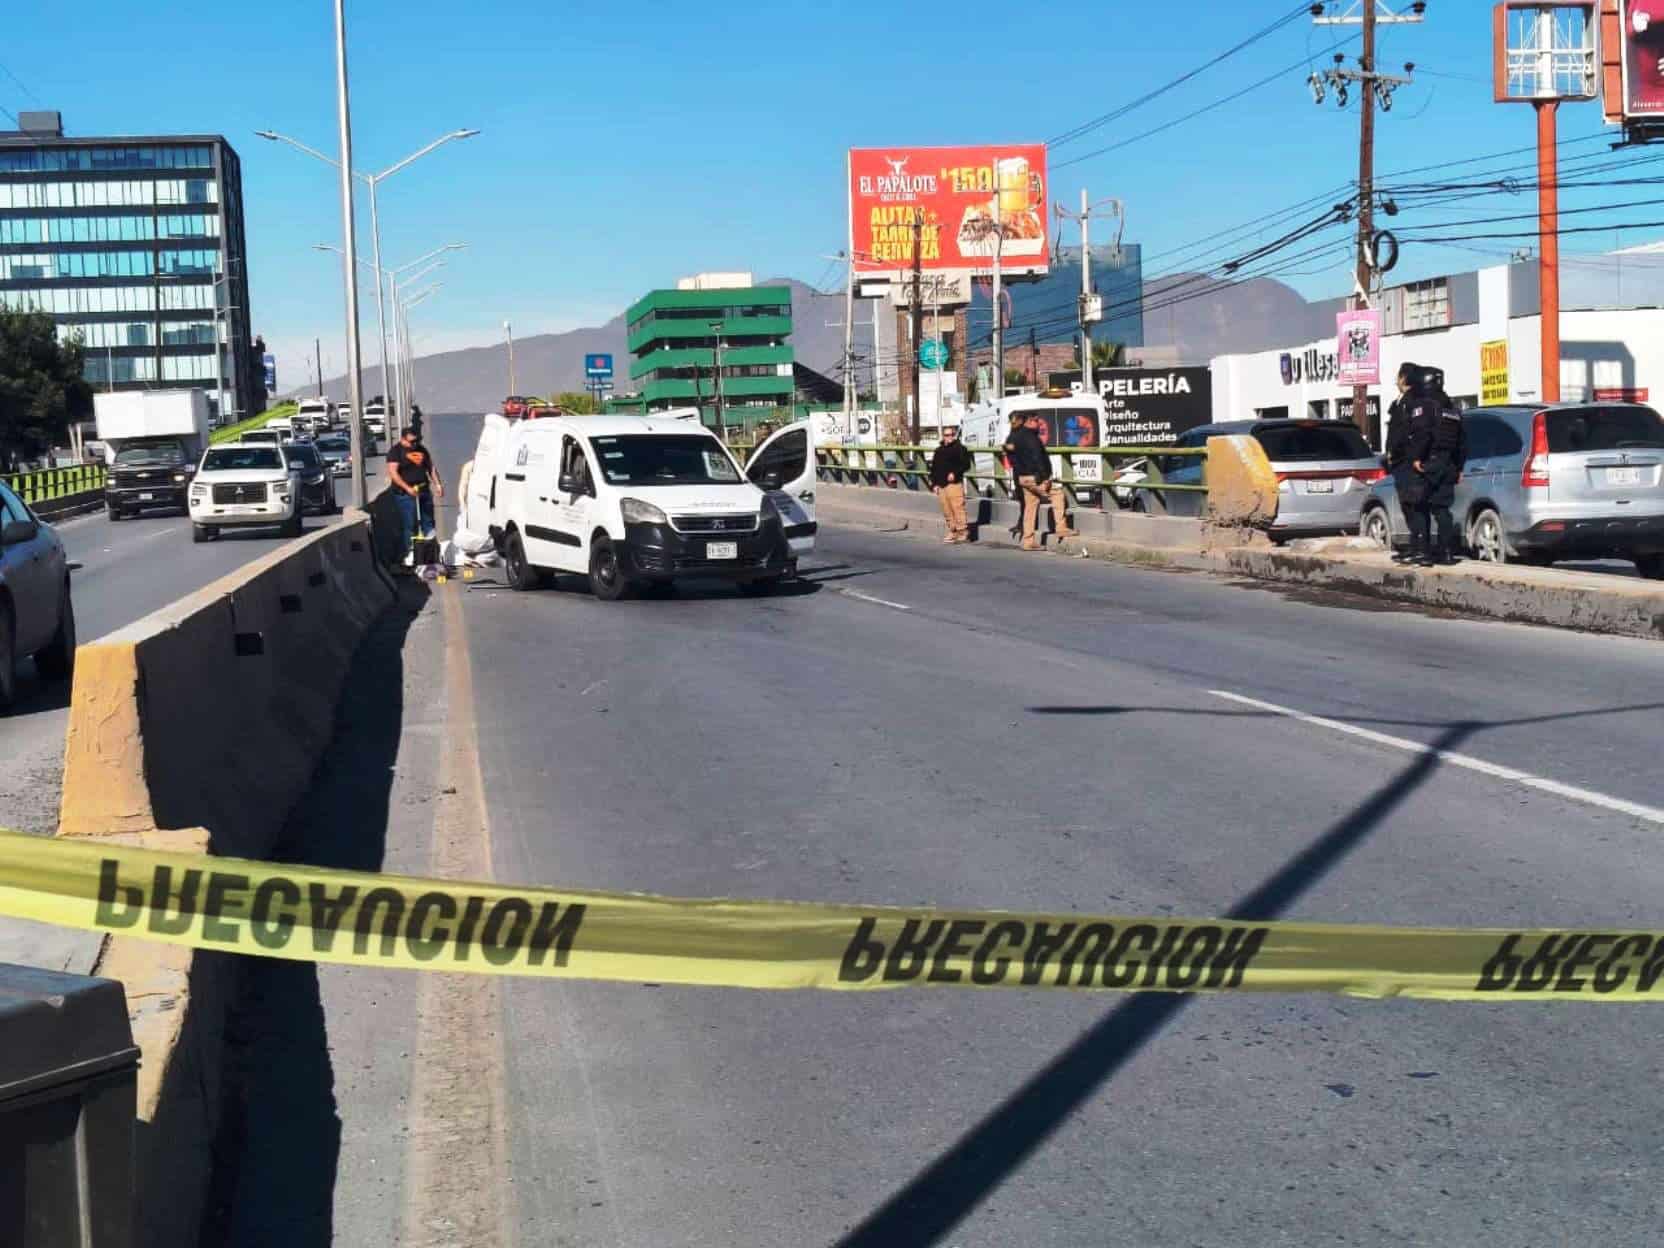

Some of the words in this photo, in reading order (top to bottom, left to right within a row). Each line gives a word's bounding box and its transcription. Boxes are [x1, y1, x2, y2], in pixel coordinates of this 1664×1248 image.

[860, 176, 873, 193] EL
[877, 175, 936, 193] PAPALOTE
[872, 242, 940, 260] CERVZA
[1071, 372, 1191, 396] PPELERÍA
